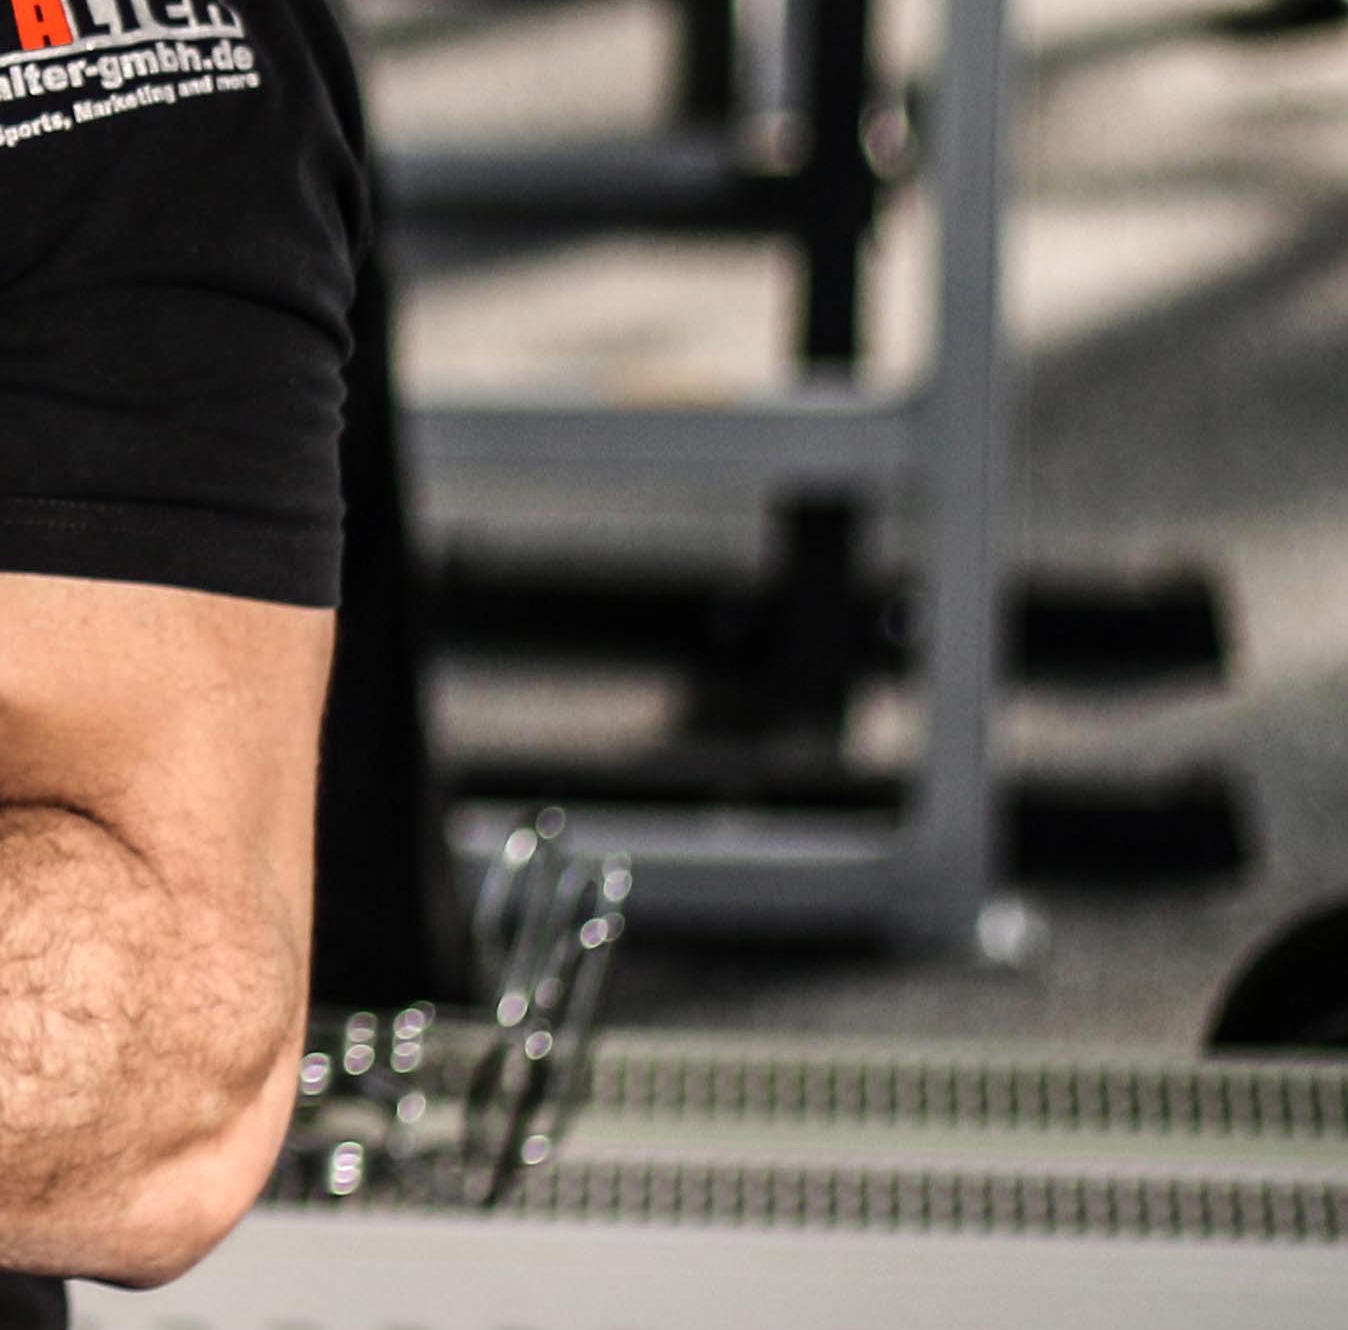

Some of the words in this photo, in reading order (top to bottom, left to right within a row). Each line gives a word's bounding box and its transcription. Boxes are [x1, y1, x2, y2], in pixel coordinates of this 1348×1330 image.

[72, 82, 176, 123] Marketing
[177, 74, 214, 98] and
[216, 72, 261, 91] more
